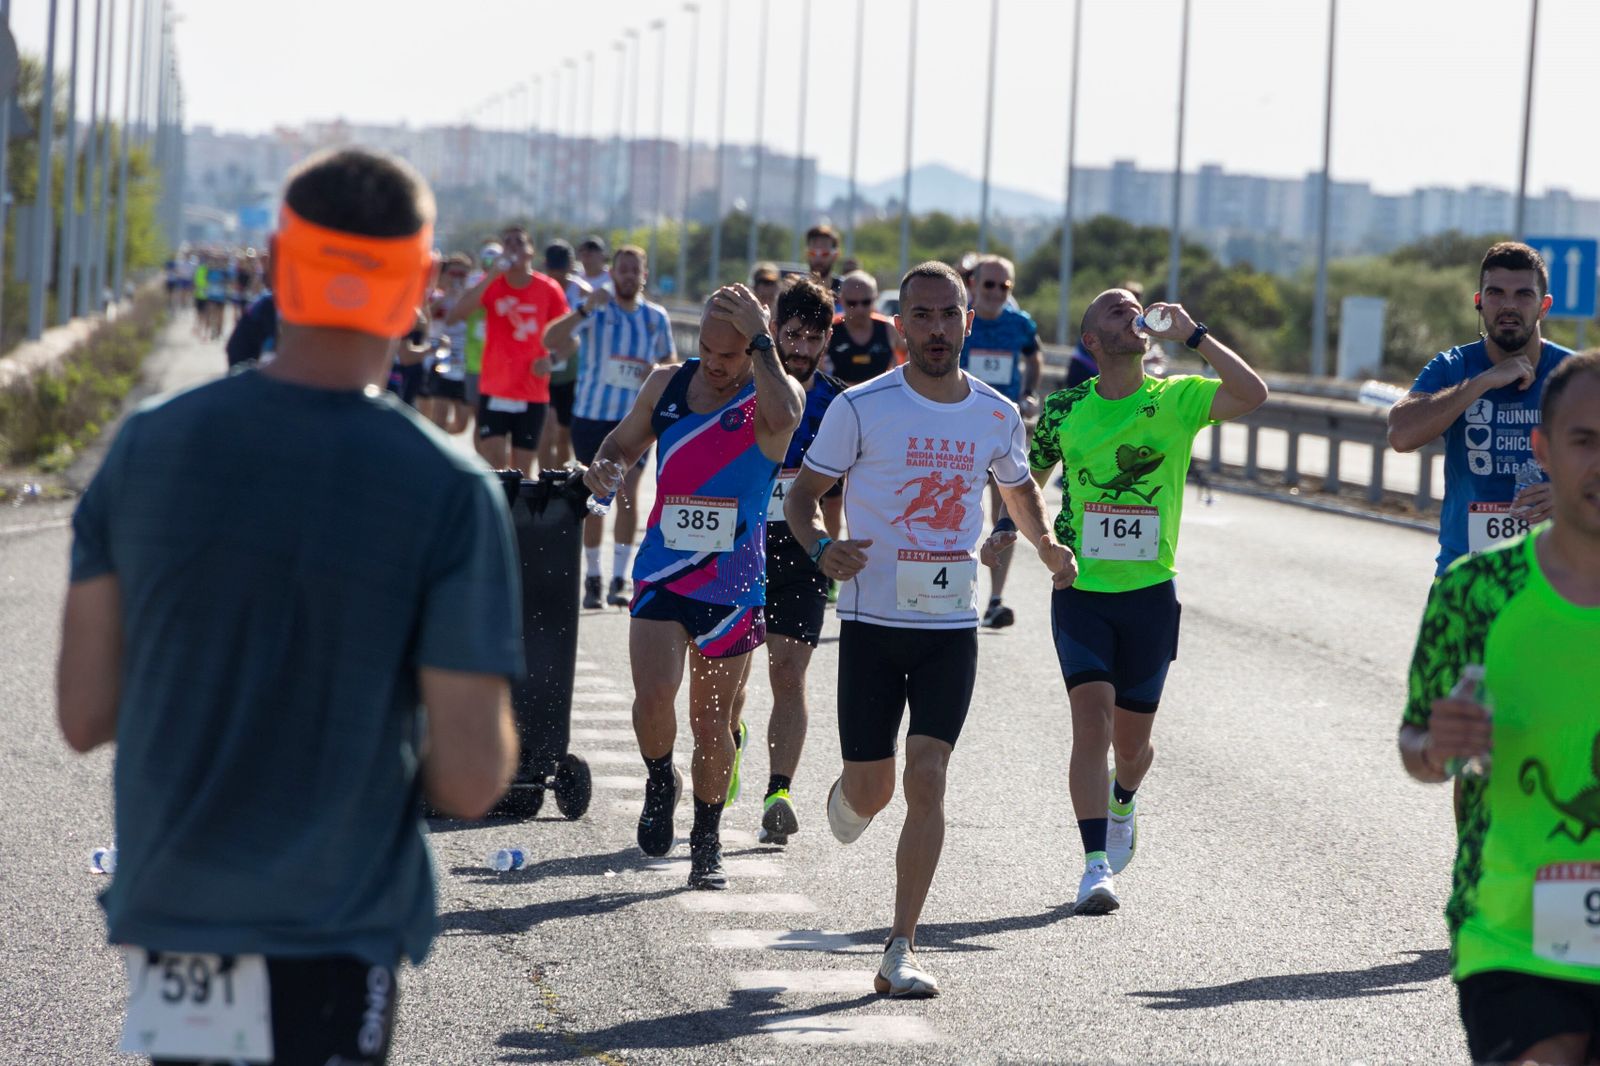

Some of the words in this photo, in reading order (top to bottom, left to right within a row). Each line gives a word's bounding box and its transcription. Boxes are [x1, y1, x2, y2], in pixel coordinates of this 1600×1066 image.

[906, 451, 933, 460] MEDIA
[937, 460, 947, 468] DE
[677, 509, 719, 530] 385
[1100, 518, 1142, 539] 164
[1487, 517, 1531, 538] 688
[933, 567, 949, 589] 4
[162, 958, 235, 1006] 591
